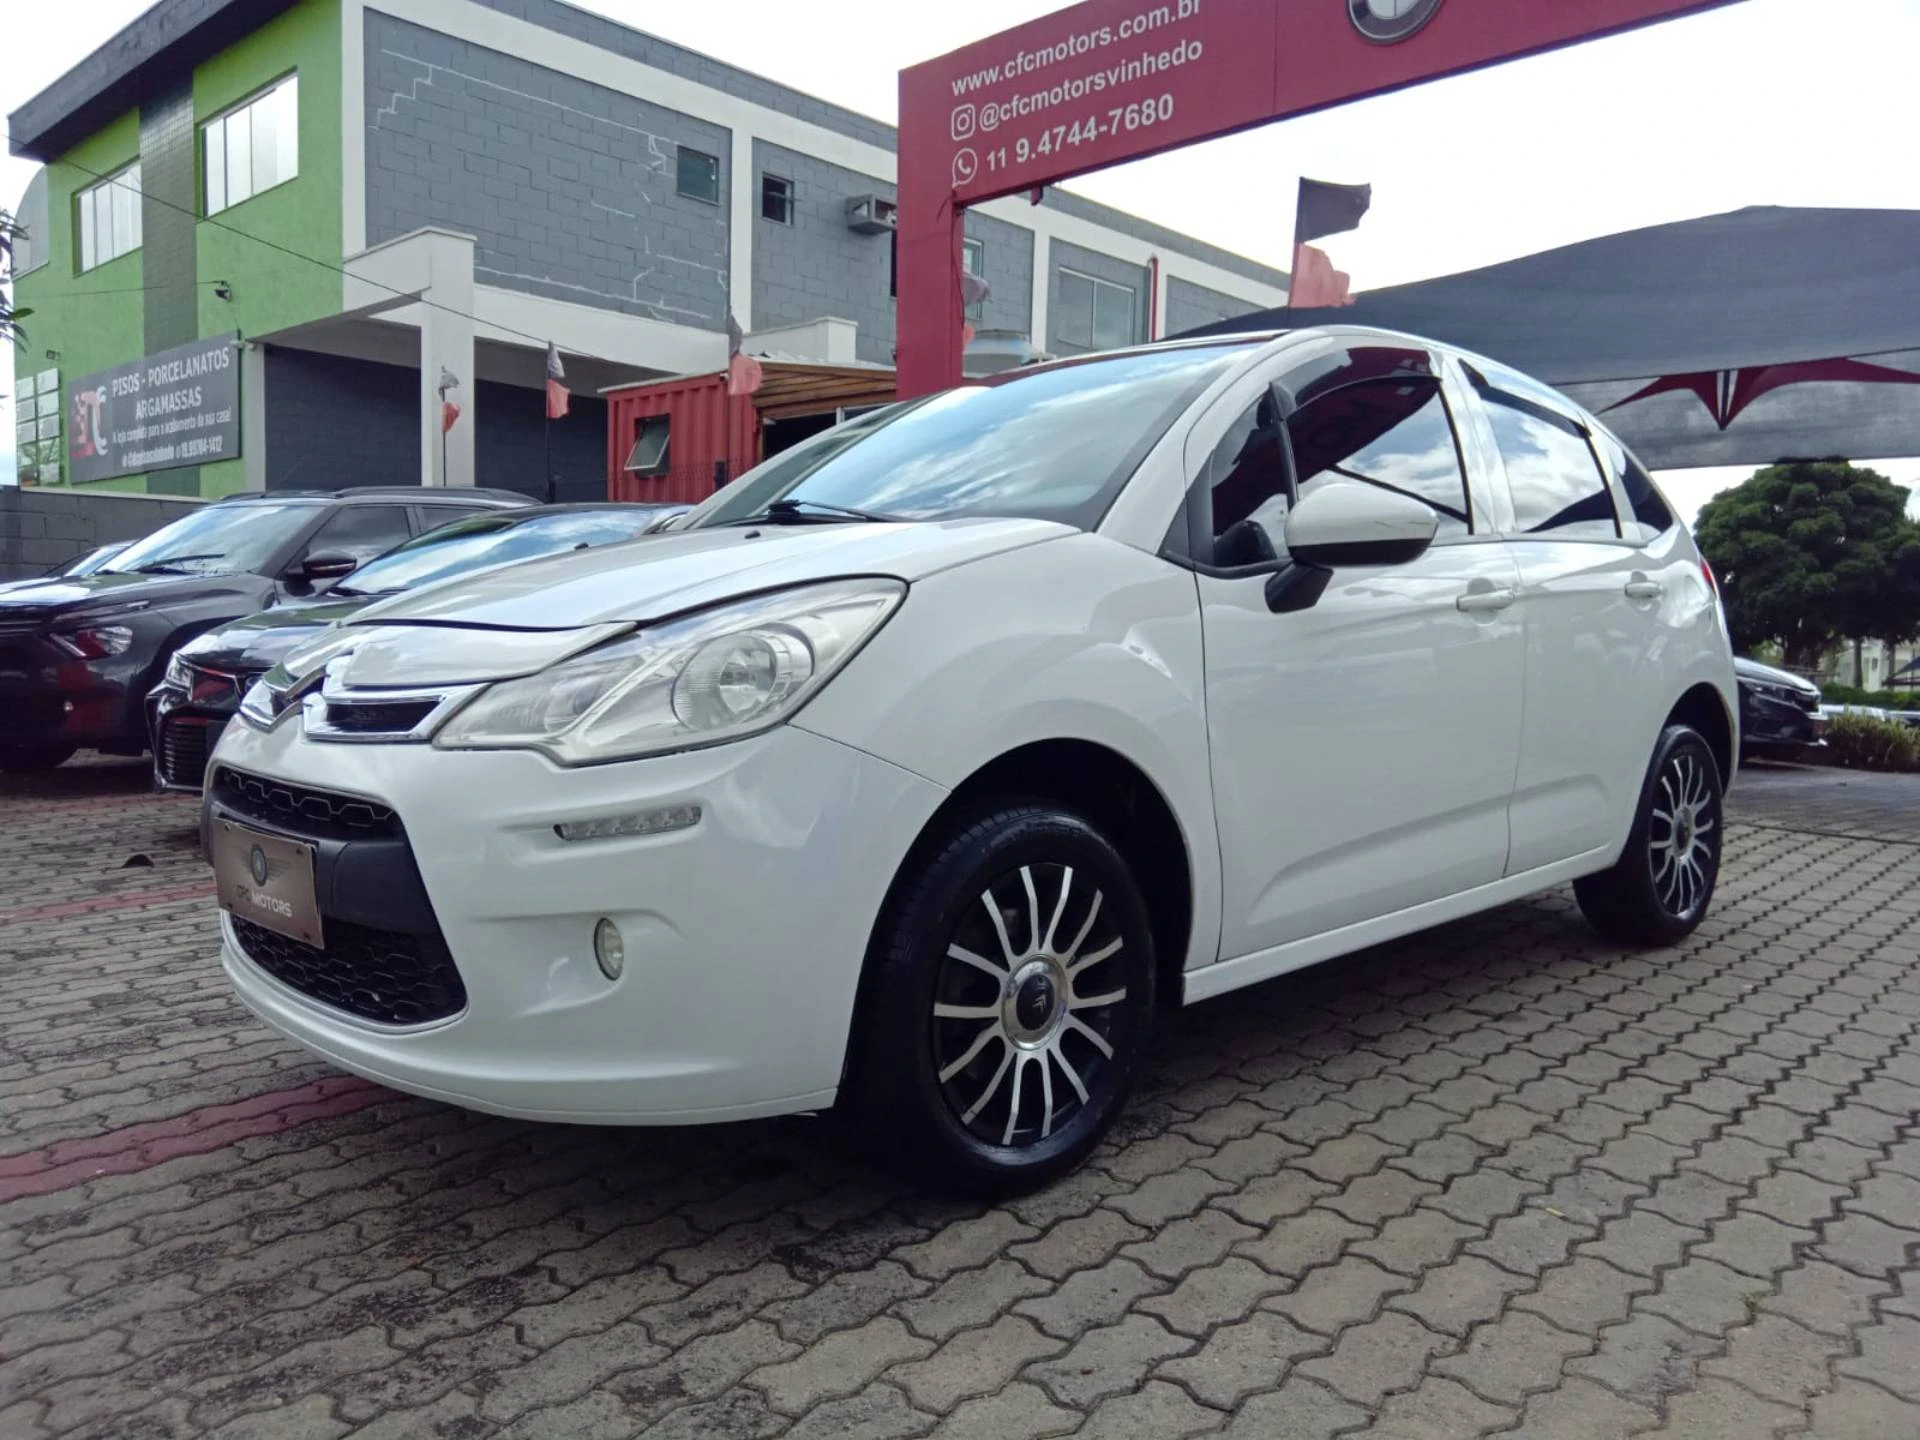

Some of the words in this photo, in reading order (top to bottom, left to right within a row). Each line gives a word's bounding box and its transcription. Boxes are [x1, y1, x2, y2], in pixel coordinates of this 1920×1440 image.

[951, 0, 1201, 97] www.cfcmotors.com.br
[979, 40, 1203, 132] @cfcmotorsvinhedo
[986, 147, 1006, 171] 11
[1015, 94, 1174, 163] 9.4744-7680
[112, 372, 140, 398] PISOS
[148, 346, 230, 387] PORCELANATOS
[135, 386, 202, 420] ARGAMASSAS
[251, 889, 293, 918] MOTORS
